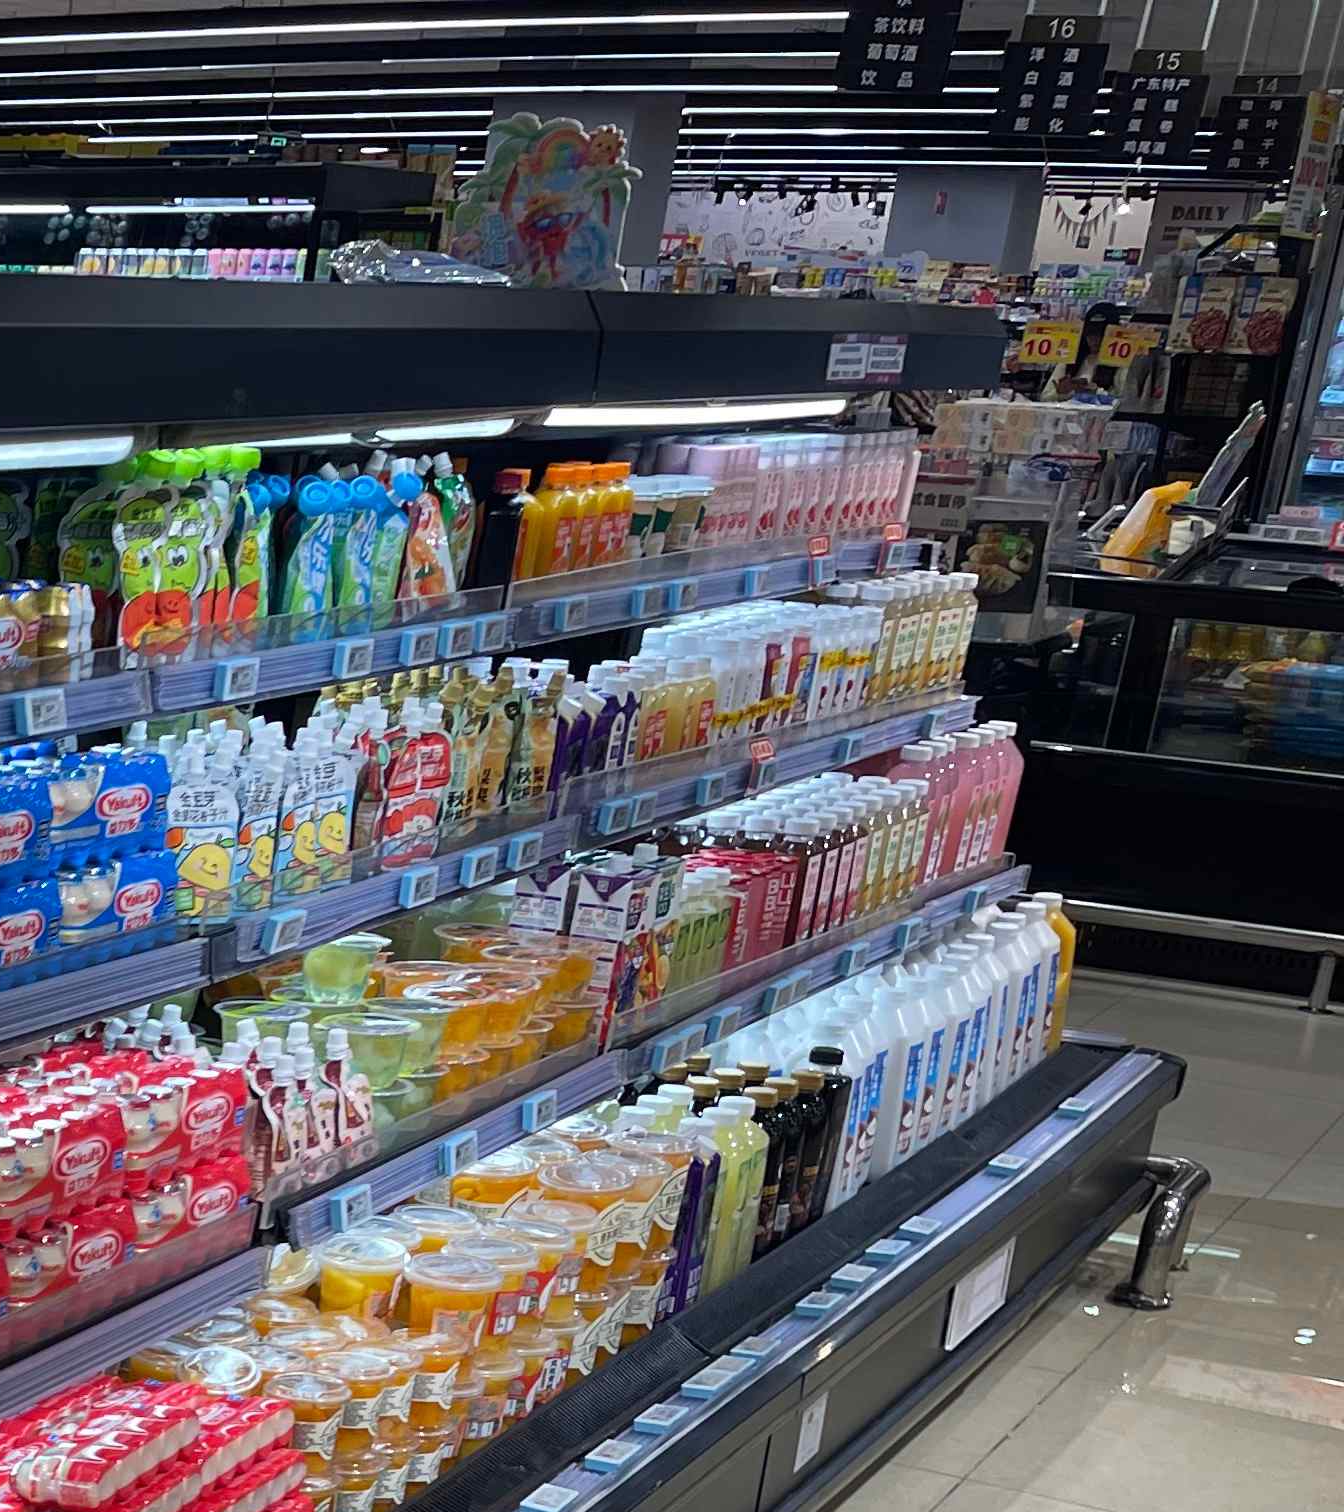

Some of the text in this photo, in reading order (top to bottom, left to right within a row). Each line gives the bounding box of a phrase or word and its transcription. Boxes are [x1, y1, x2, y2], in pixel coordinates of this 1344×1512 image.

[873, 17, 925, 36] 茶饮料
[1048, 18, 1076, 39] 16
[866, 43, 919, 62] 葡萄酒
[1156, 52, 1182, 71] 15
[1023, 71, 1073, 87] 白酒
[1130, 77, 1191, 92] 广东特产
[1171, 204, 1230, 222] DAILY
[1024, 339, 1052, 357] 10
[1107, 341, 1132, 358] 10
[101, 791, 147, 814] Yakult
[119, 886, 158, 910] Yakult
[188, 1103, 231, 1126] Yakult
[59, 1147, 104, 1172] Yakult
[193, 1190, 234, 1214] Yakult
[73, 1241, 117, 1269] Yakult
